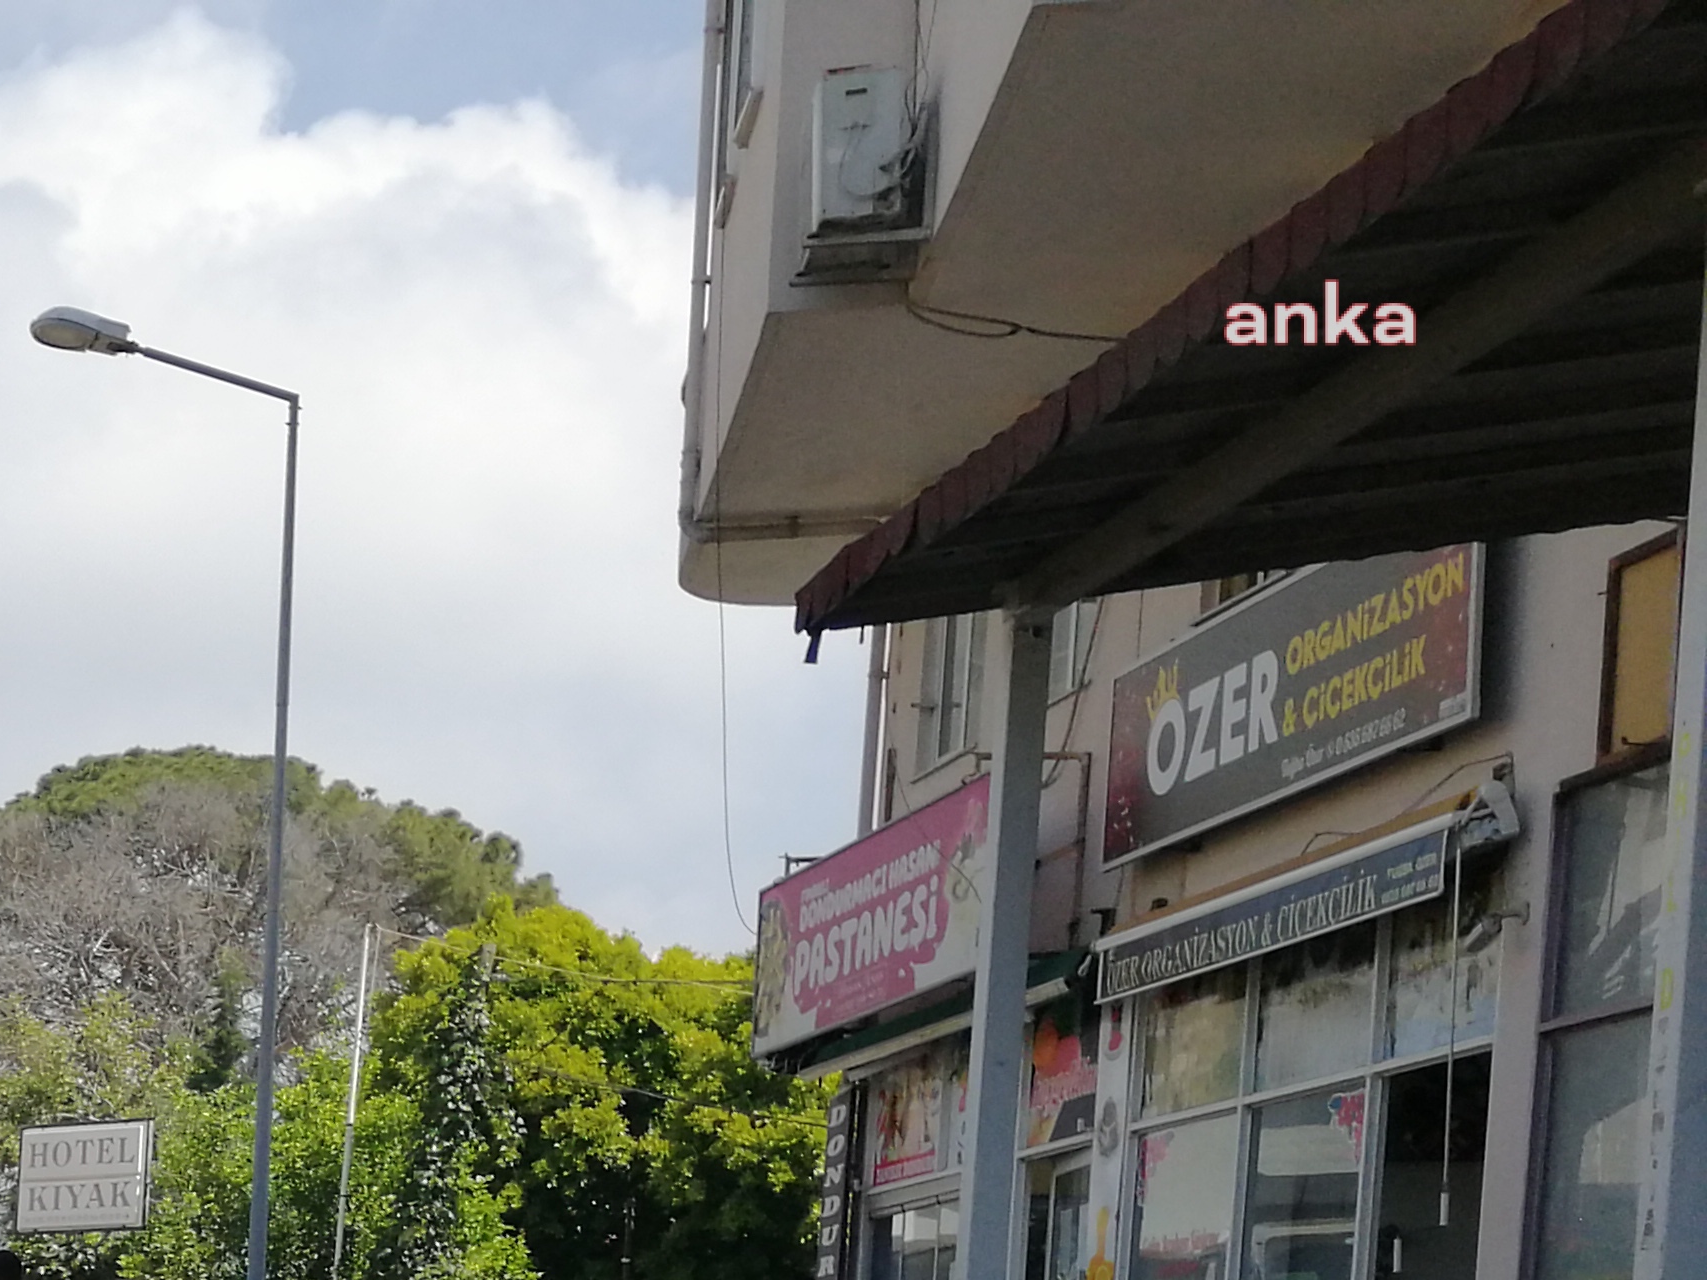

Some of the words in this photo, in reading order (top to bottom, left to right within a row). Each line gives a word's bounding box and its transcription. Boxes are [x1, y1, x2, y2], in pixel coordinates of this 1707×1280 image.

[1283, 697, 1295, 737] &
[794, 874, 939, 997] PASTANESİ
[1106, 949, 1138, 995] ÖZER
[1141, 915, 1259, 978] ORGANİZASYON
[1261, 912, 1273, 946] &
[1277, 869, 1377, 943] ÇİÇEKÇİLİK
[29, 1137, 135, 1168] HOTEL
[27, 1181, 131, 1212] KIYAK
